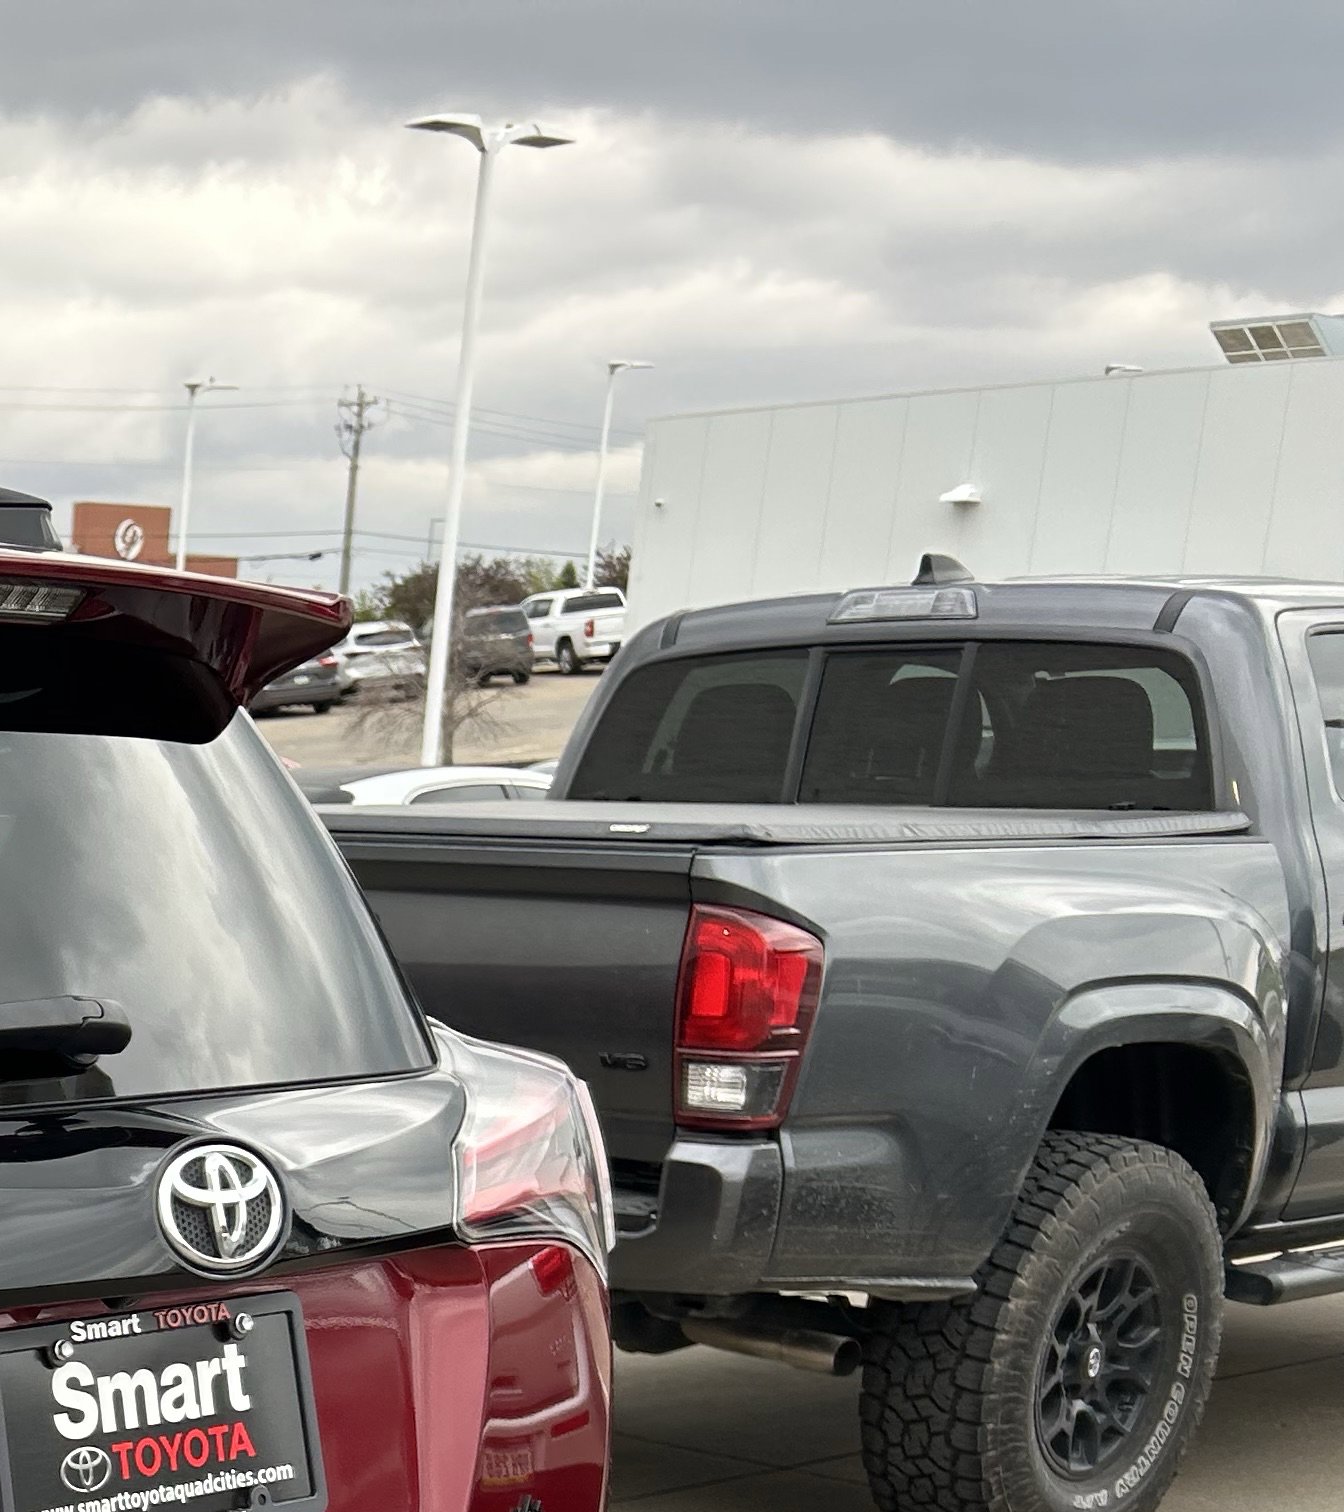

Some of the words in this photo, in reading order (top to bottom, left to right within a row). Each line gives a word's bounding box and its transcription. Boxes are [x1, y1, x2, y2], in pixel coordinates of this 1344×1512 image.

[70, 1312, 142, 1344] Smart
[154, 1303, 232, 1331] TOYOTA
[1176, 1293, 1198, 1379] OPEN
[51, 1343, 251, 1441] Smart
[111, 1421, 257, 1481] TOYOTA
[1115, 1381, 1186, 1499] COUNTRY
